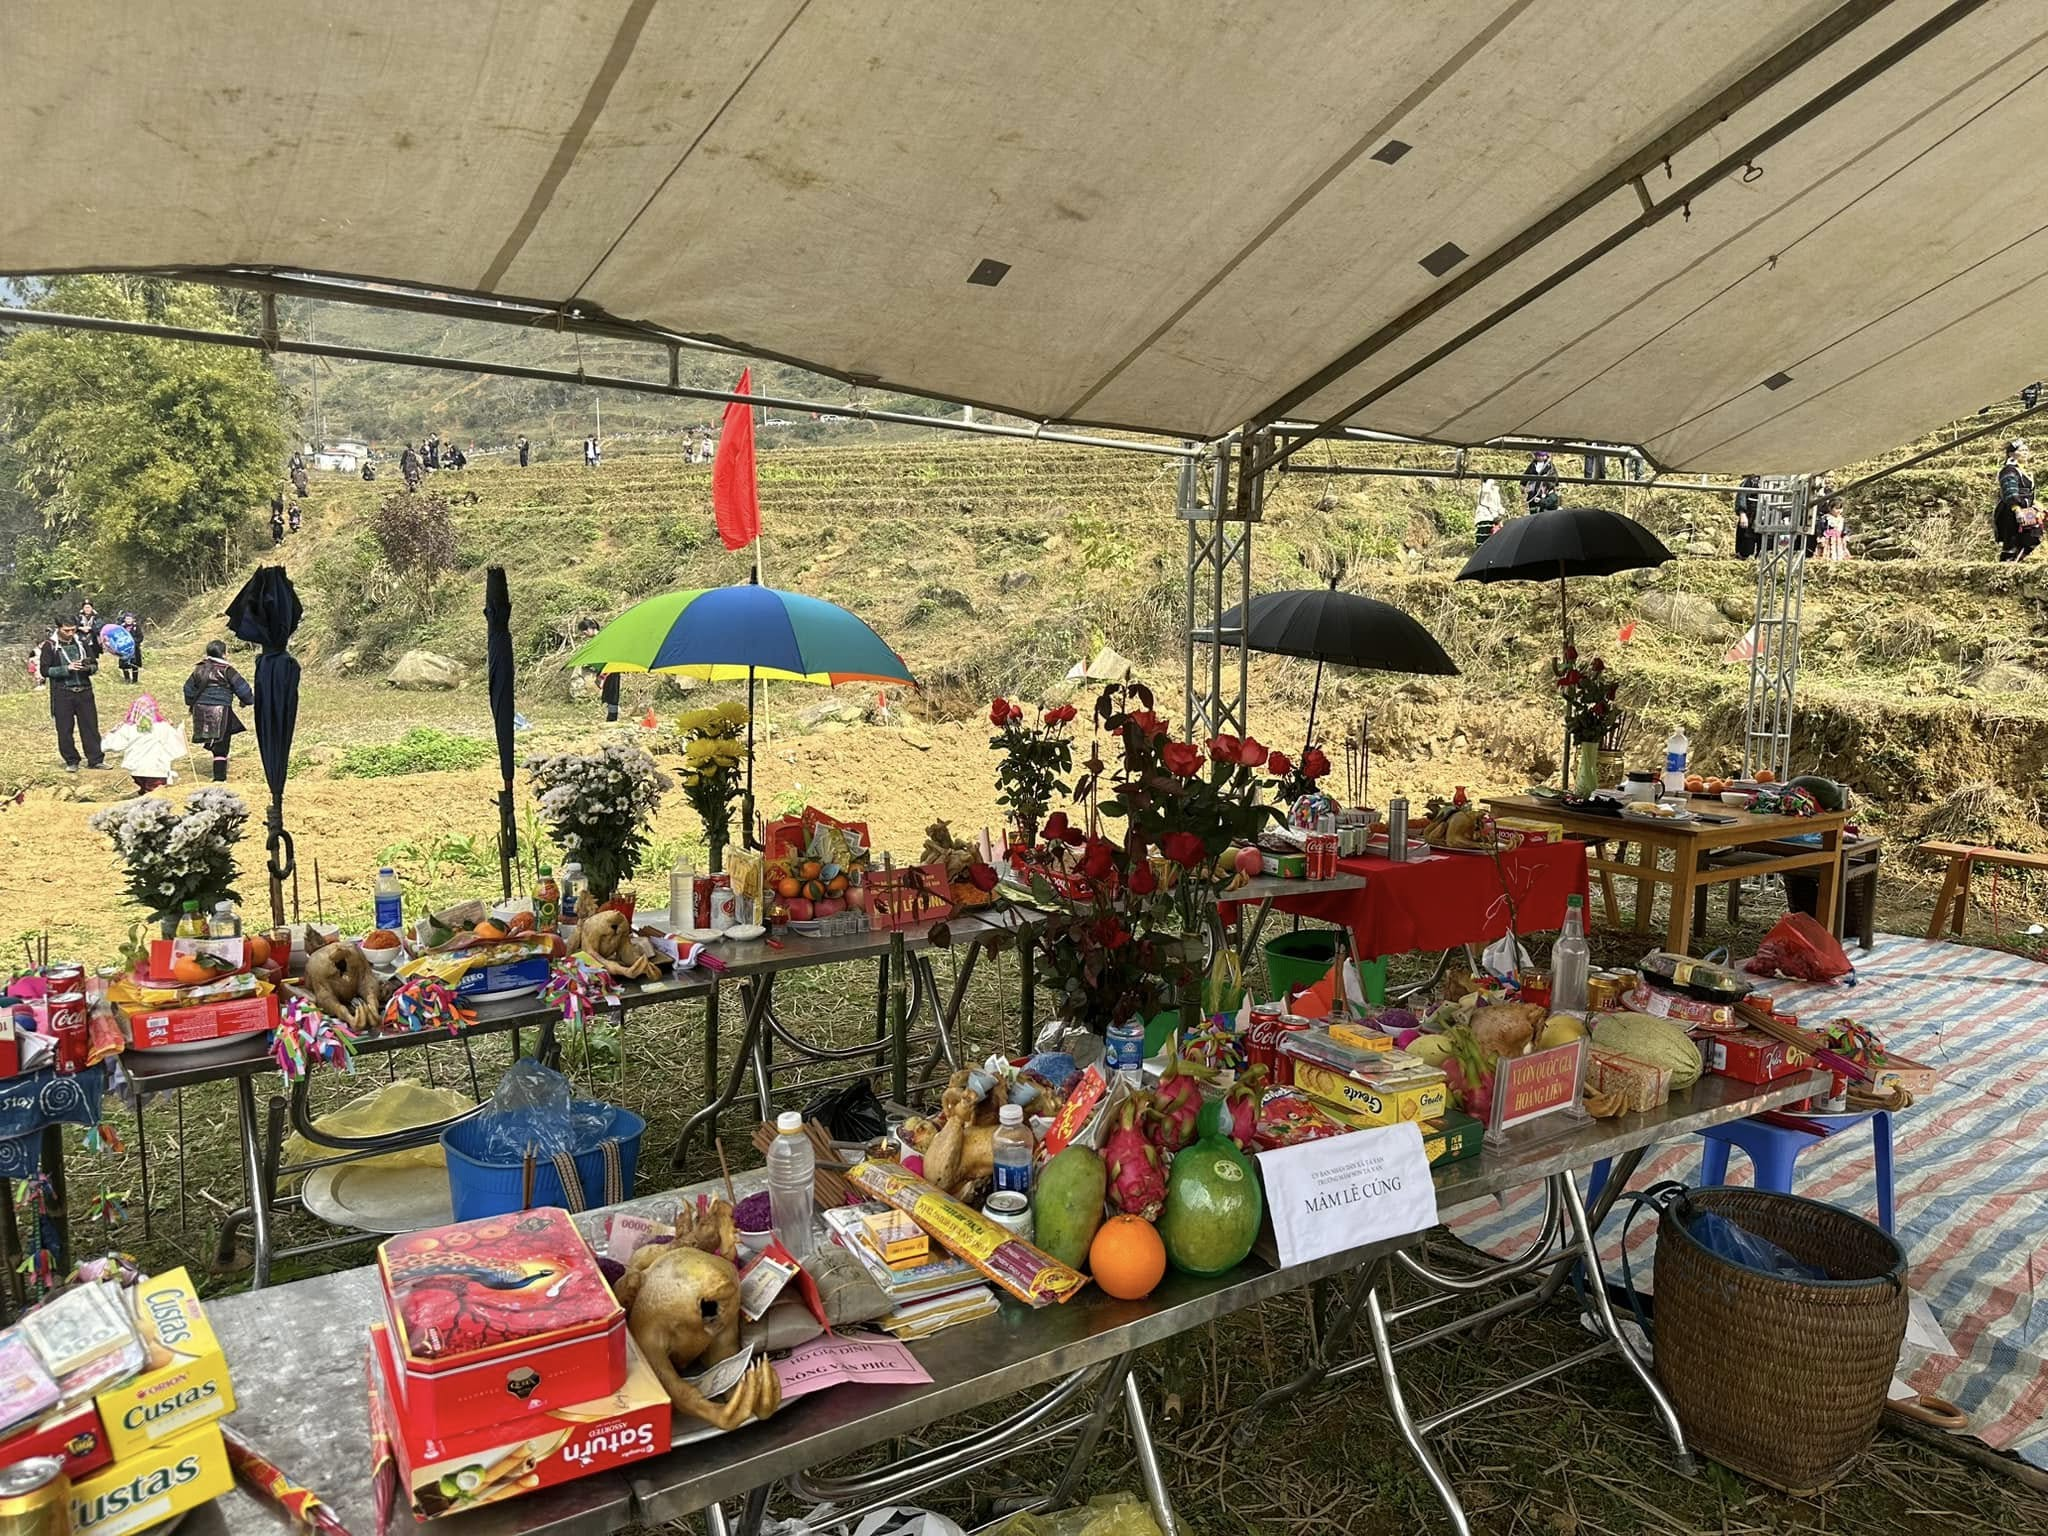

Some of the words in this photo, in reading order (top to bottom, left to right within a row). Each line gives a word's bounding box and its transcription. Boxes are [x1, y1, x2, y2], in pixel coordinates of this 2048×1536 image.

[460, 973, 484, 985] REO
[1560, 1056, 1573, 1073] GIA
[1343, 1085, 1383, 1114] Goute
[1420, 1093, 1443, 1106] Goute
[1304, 1191, 1341, 1214] MÂM
[1343, 1183, 1362, 1204] LỄ
[1362, 1176, 1402, 1198] CÚNG
[146, 1287, 190, 1346] Custas
[813, 1348, 836, 1357] GIA
[122, 1378, 217, 1431] Custas
[563, 1423, 653, 1462] Saturn
[588, 1421, 628, 1438] ASSORTED
[72, 1454, 201, 1530] ustas
